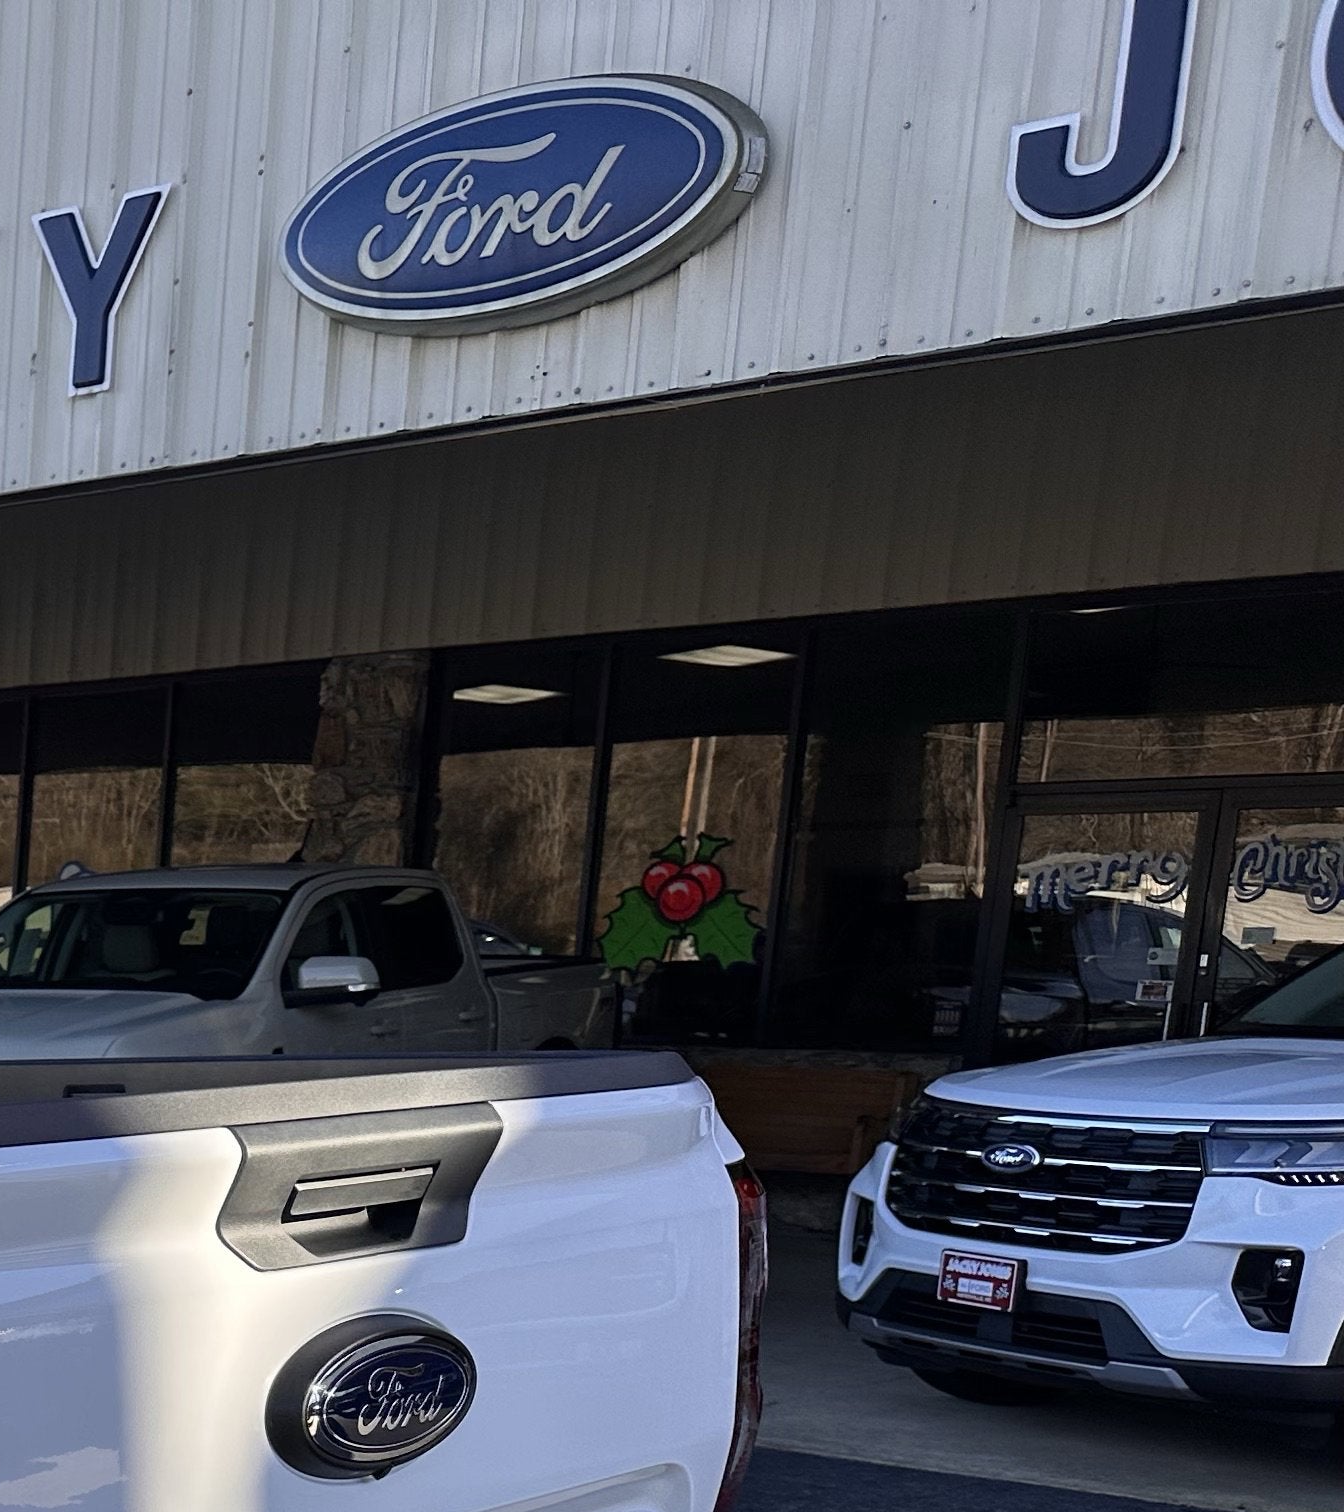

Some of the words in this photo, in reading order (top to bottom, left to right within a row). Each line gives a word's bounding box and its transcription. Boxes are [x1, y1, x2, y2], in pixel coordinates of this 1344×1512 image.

[1006, 0, 1344, 229] J
[357, 132, 626, 280] Ford
[358, 1363, 444, 1436] Ford
